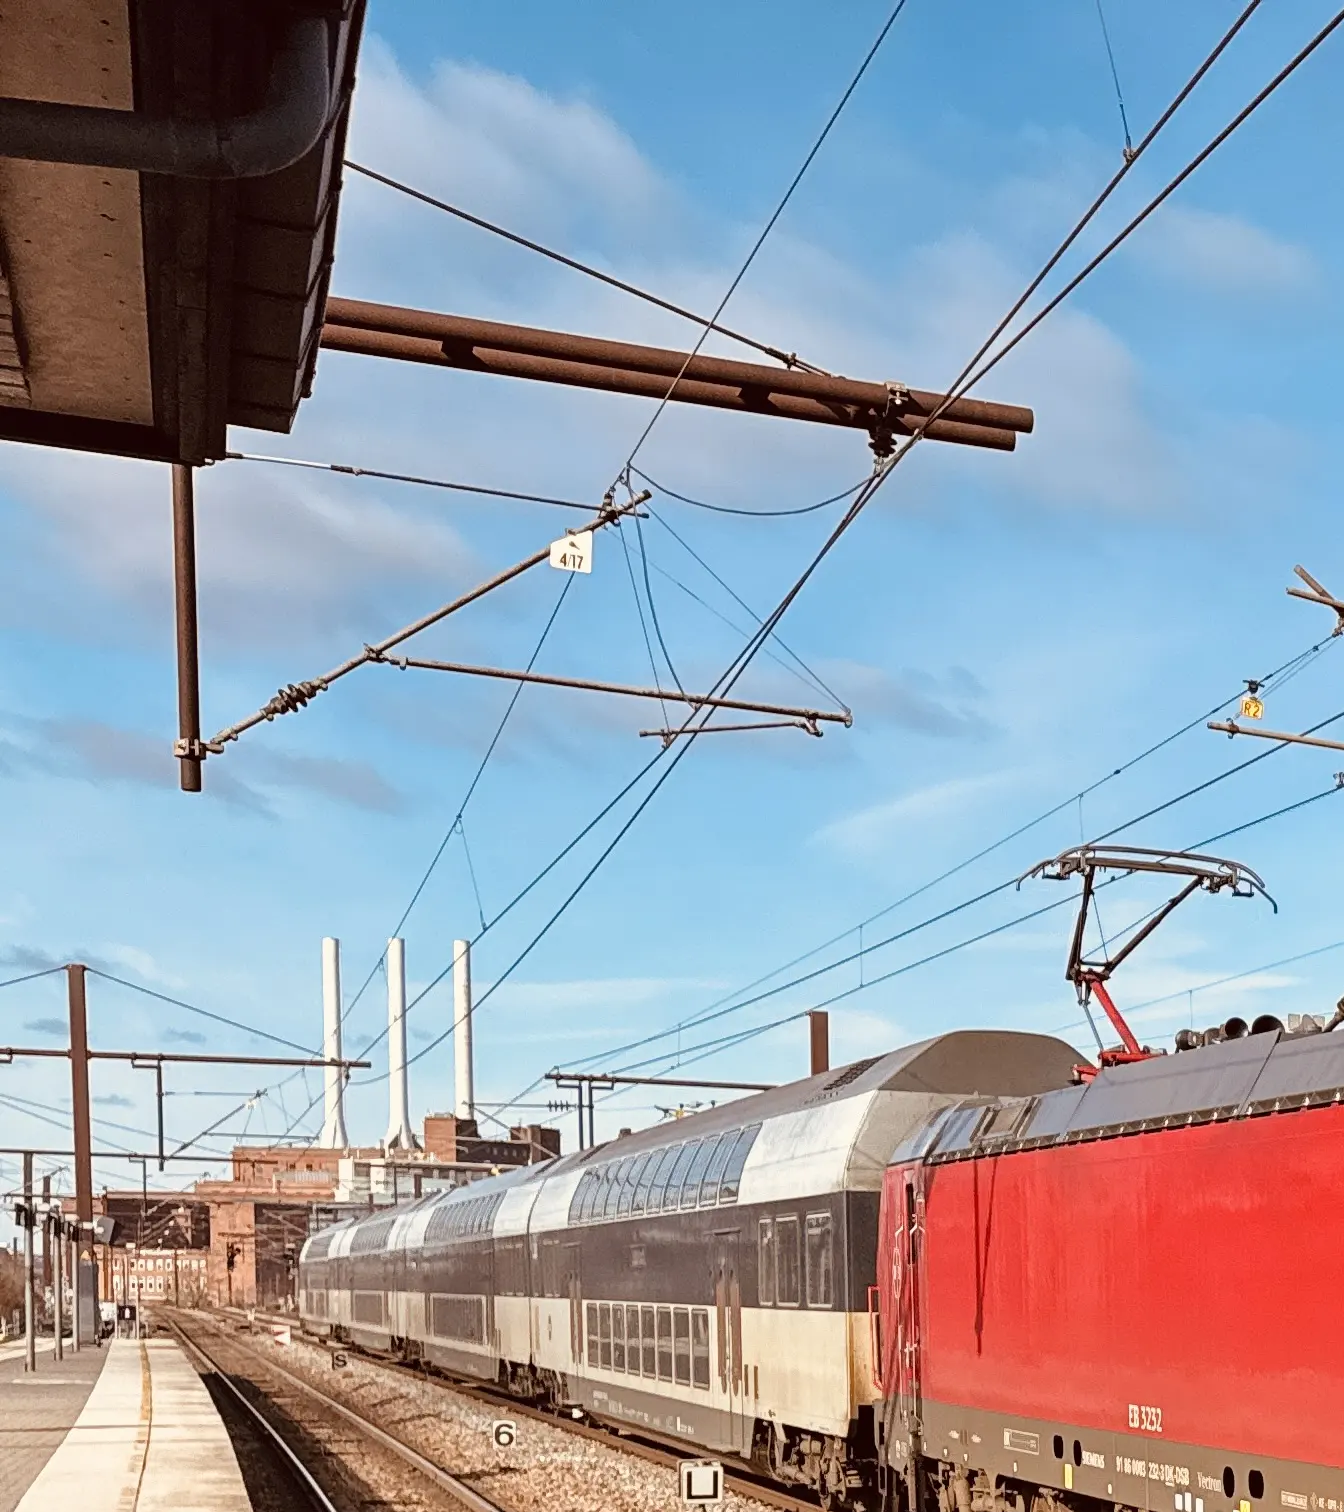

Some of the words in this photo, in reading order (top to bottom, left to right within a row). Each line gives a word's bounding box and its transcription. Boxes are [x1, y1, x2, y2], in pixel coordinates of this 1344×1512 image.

[560, 553, 584, 569] 4/17
[1244, 701, 1260, 718] R2
[1128, 1404, 1140, 1428] EB
[1141, 1406, 1162, 1432] 3232
[494, 1423, 515, 1446] 6
